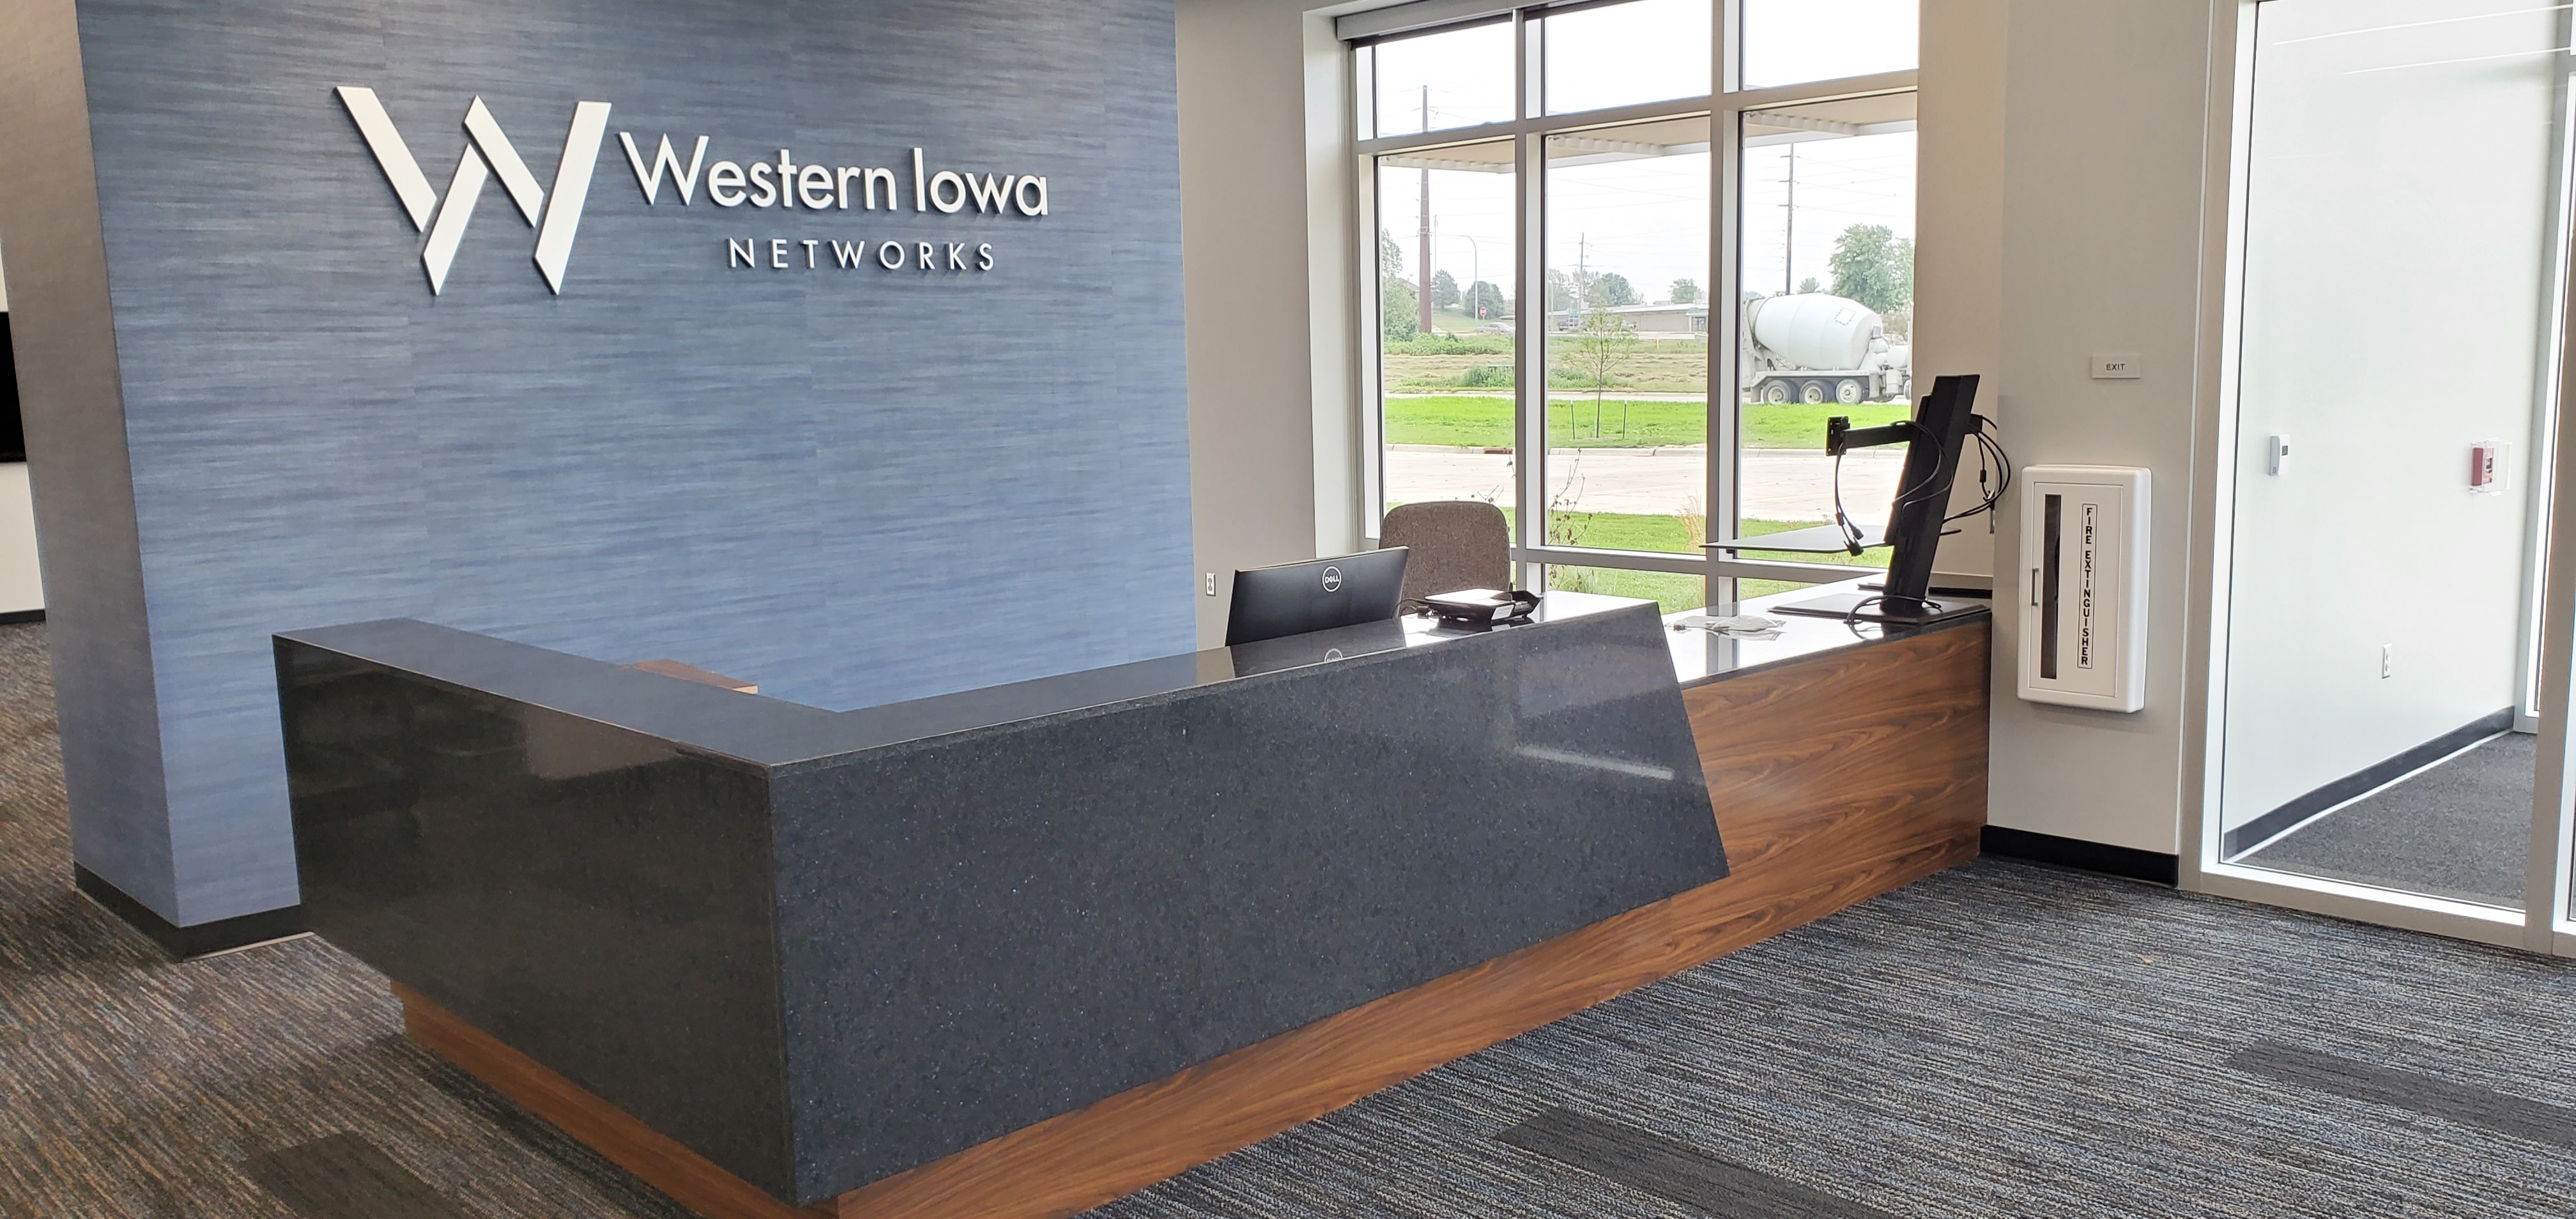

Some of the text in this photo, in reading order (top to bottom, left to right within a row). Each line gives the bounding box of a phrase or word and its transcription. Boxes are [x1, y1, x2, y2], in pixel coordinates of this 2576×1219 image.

[618, 131, 1049, 216] Western Iowa
[729, 236, 995, 272] NETWORKS
[1324, 575, 1339, 583] DELL
[2081, 550, 2092, 665] EXTINGUISHER
